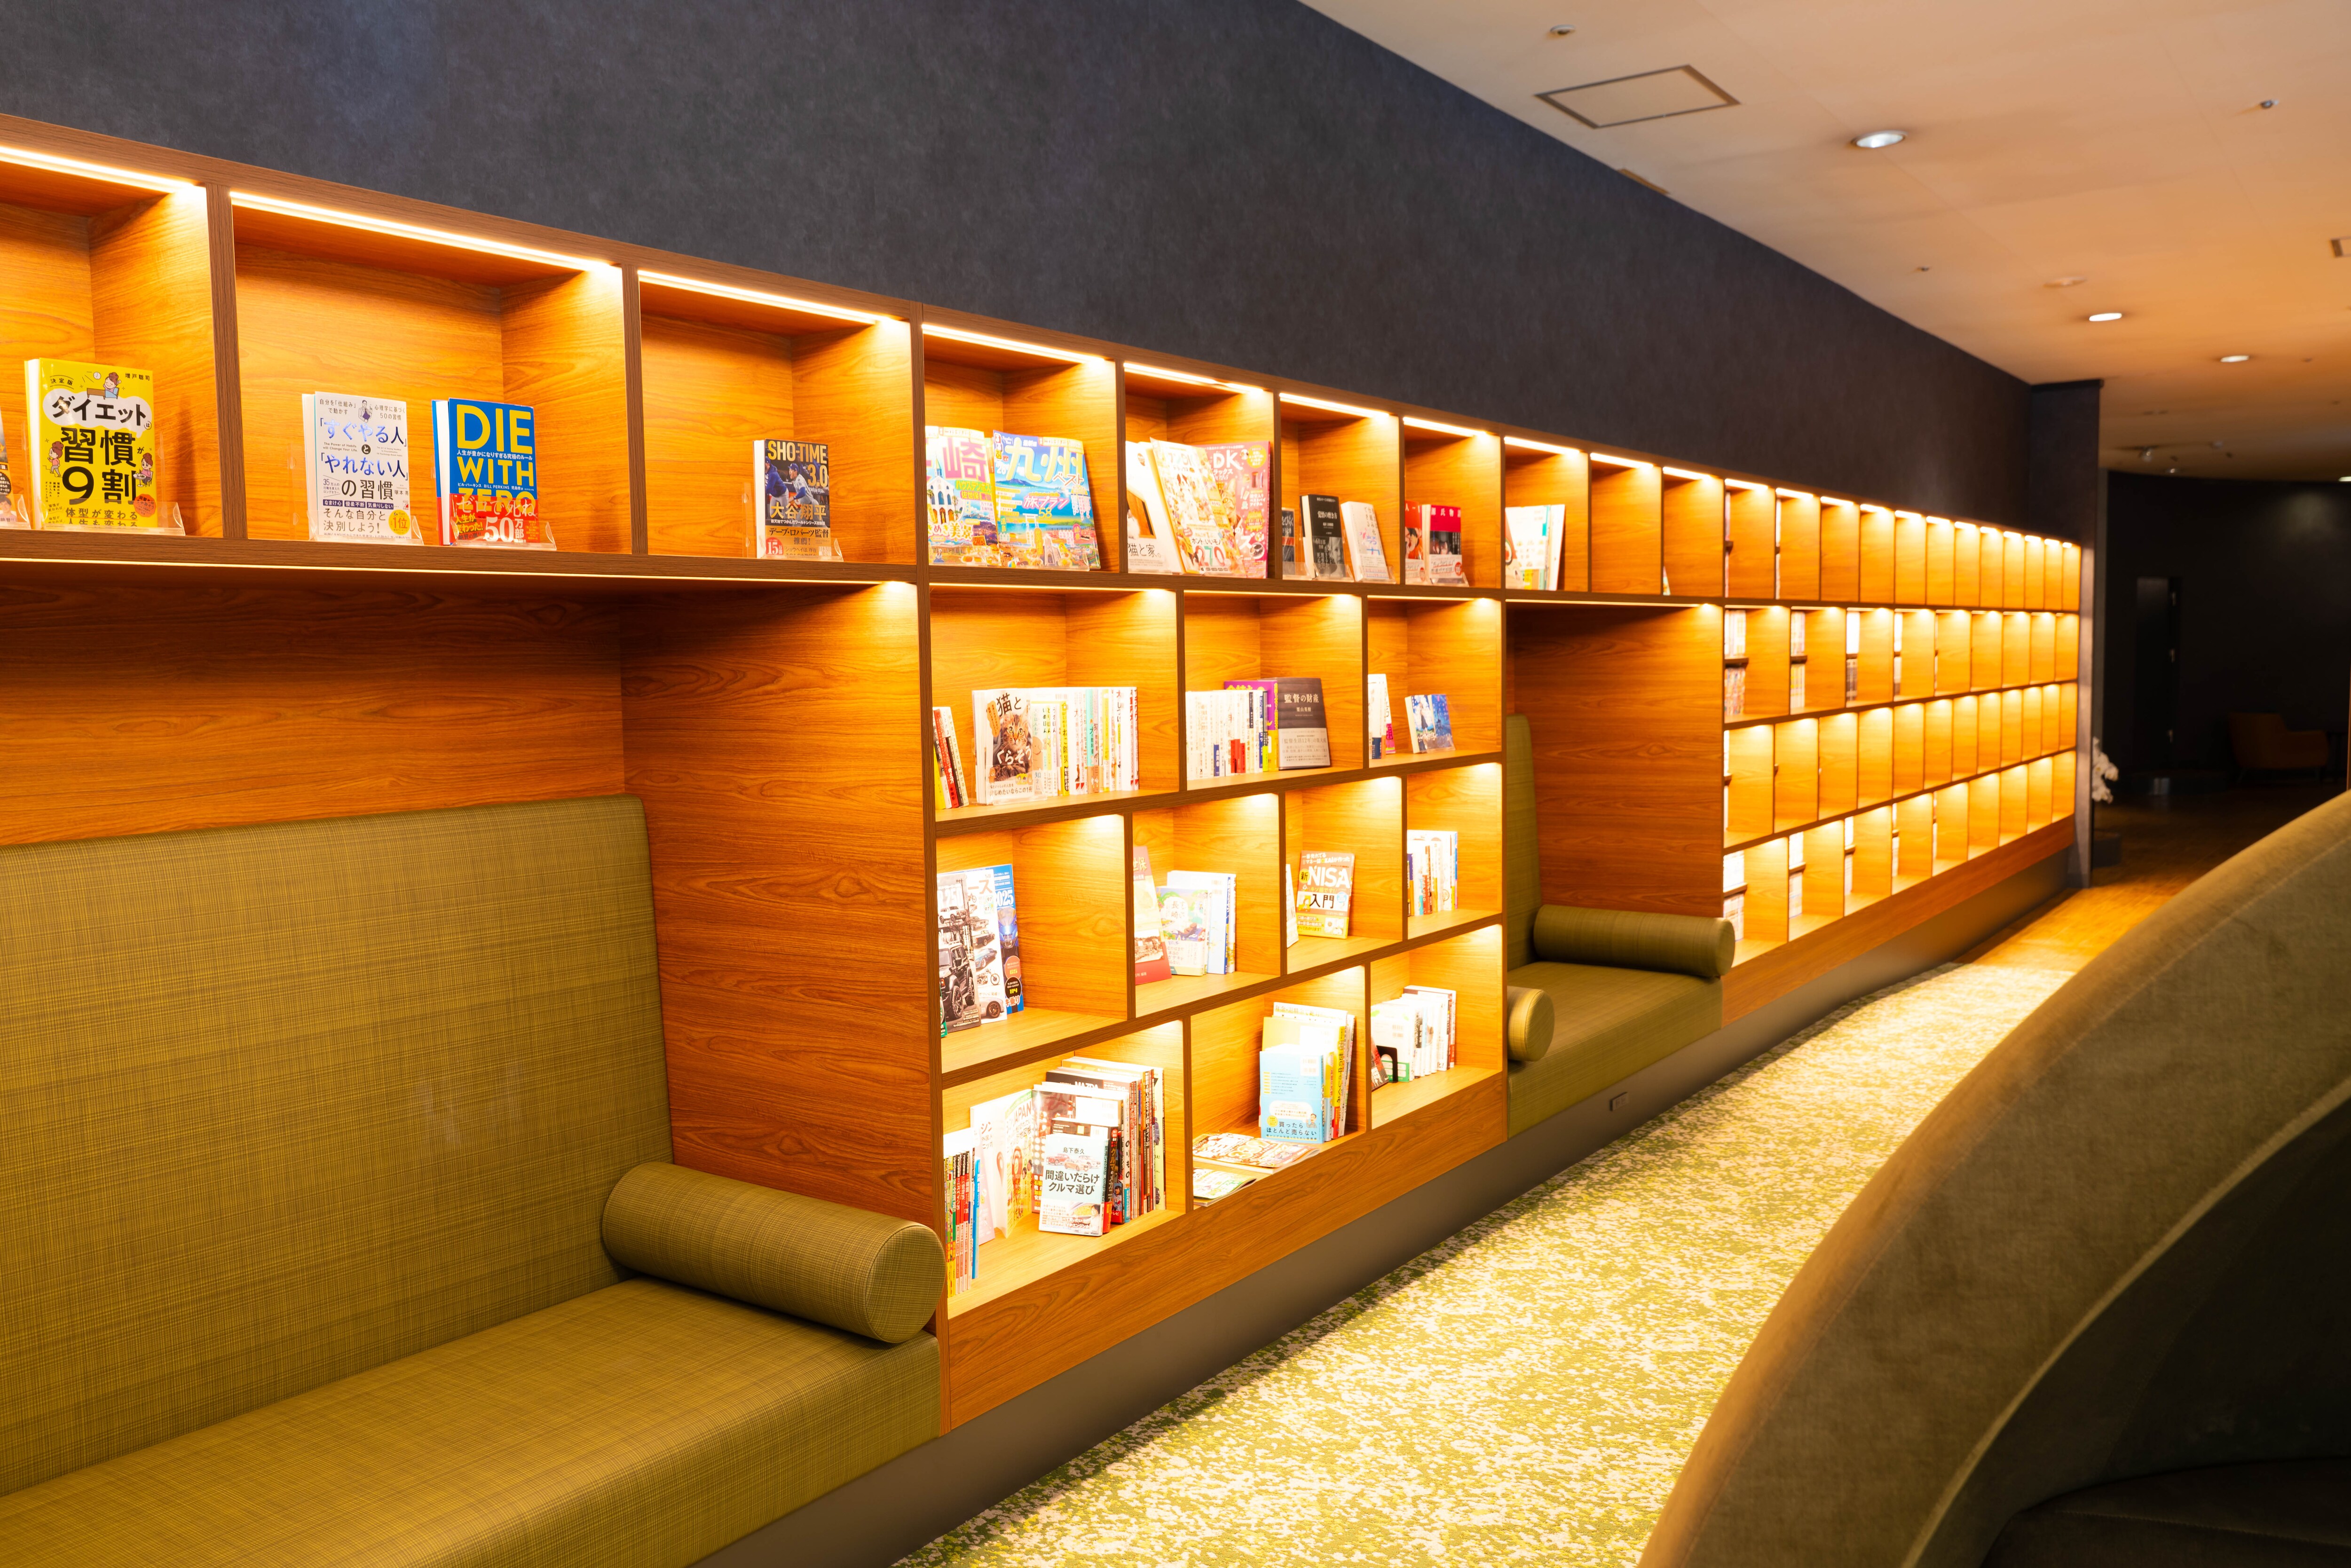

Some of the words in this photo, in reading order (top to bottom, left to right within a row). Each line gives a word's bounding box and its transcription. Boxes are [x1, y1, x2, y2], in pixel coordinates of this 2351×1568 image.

[319, 399, 356, 409] 自分を「仕組み」
[374, 405, 405, 413] 心理学に基づく
[320, 418, 407, 447] 「すぐやる人」
[457, 404, 533, 454] DIE
[61, 427, 144, 467] 習慣が
[457, 449, 533, 460] 人生が豊かになりすぎる究極のルール
[767, 440, 827, 464] SHO-TIME
[321, 452, 408, 481] 「やれない人」
[1005, 437, 1084, 483] 九州
[457, 457, 534, 487] WITH
[807, 464, 828, 487] 3.0
[1053, 472, 1084, 486] ベスト
[62, 466, 137, 505] 9割
[341, 480, 393, 500] の習慣
[457, 496, 538, 519] ゼロで死ね。
[770, 502, 826, 520] 大谷翔平
[1023, 496, 1069, 508] 旅プラン
[65, 507, 138, 520] 体型が変わる
[323, 508, 386, 521] そんな自分と
[1038, 508, 1053, 519] 58
[393, 518, 408, 528] 1位
[485, 516, 514, 542] 50
[514, 519, 524, 538] 万部
[769, 527, 829, 538] デーブ・ロバーツ監督
[767, 542, 778, 555] 15
[1195, 545, 1225, 567] 270
[996, 693, 1021, 717] 猫と
[1284, 694, 1319, 703] 監督の財産
[997, 745, 1031, 765] くらそう
[1301, 872, 1308, 881] 新
[1307, 866, 1350, 888] NISA
[1309, 894, 1334, 908] 入門
[1045, 1170, 1100, 1184] 間違いだらけ
[1049, 1182, 1095, 1195] クルマ選び
